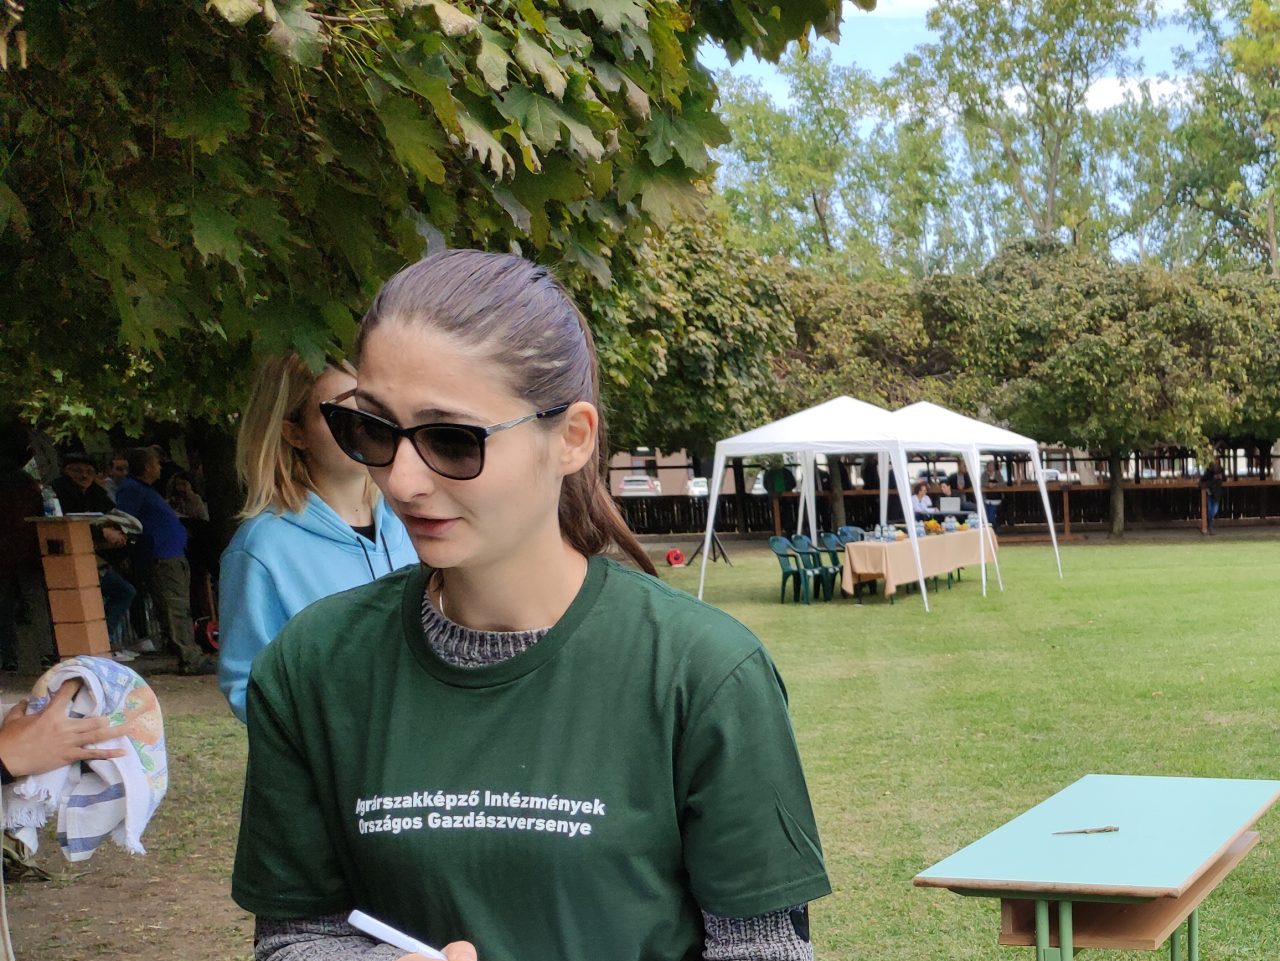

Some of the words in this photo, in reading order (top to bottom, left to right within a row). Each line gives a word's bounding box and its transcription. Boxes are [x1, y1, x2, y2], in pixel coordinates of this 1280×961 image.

[485, 790, 606, 816] Intézmények
[358, 812, 423, 835] Országos
[428, 811, 592, 837] Gazdászversenye
